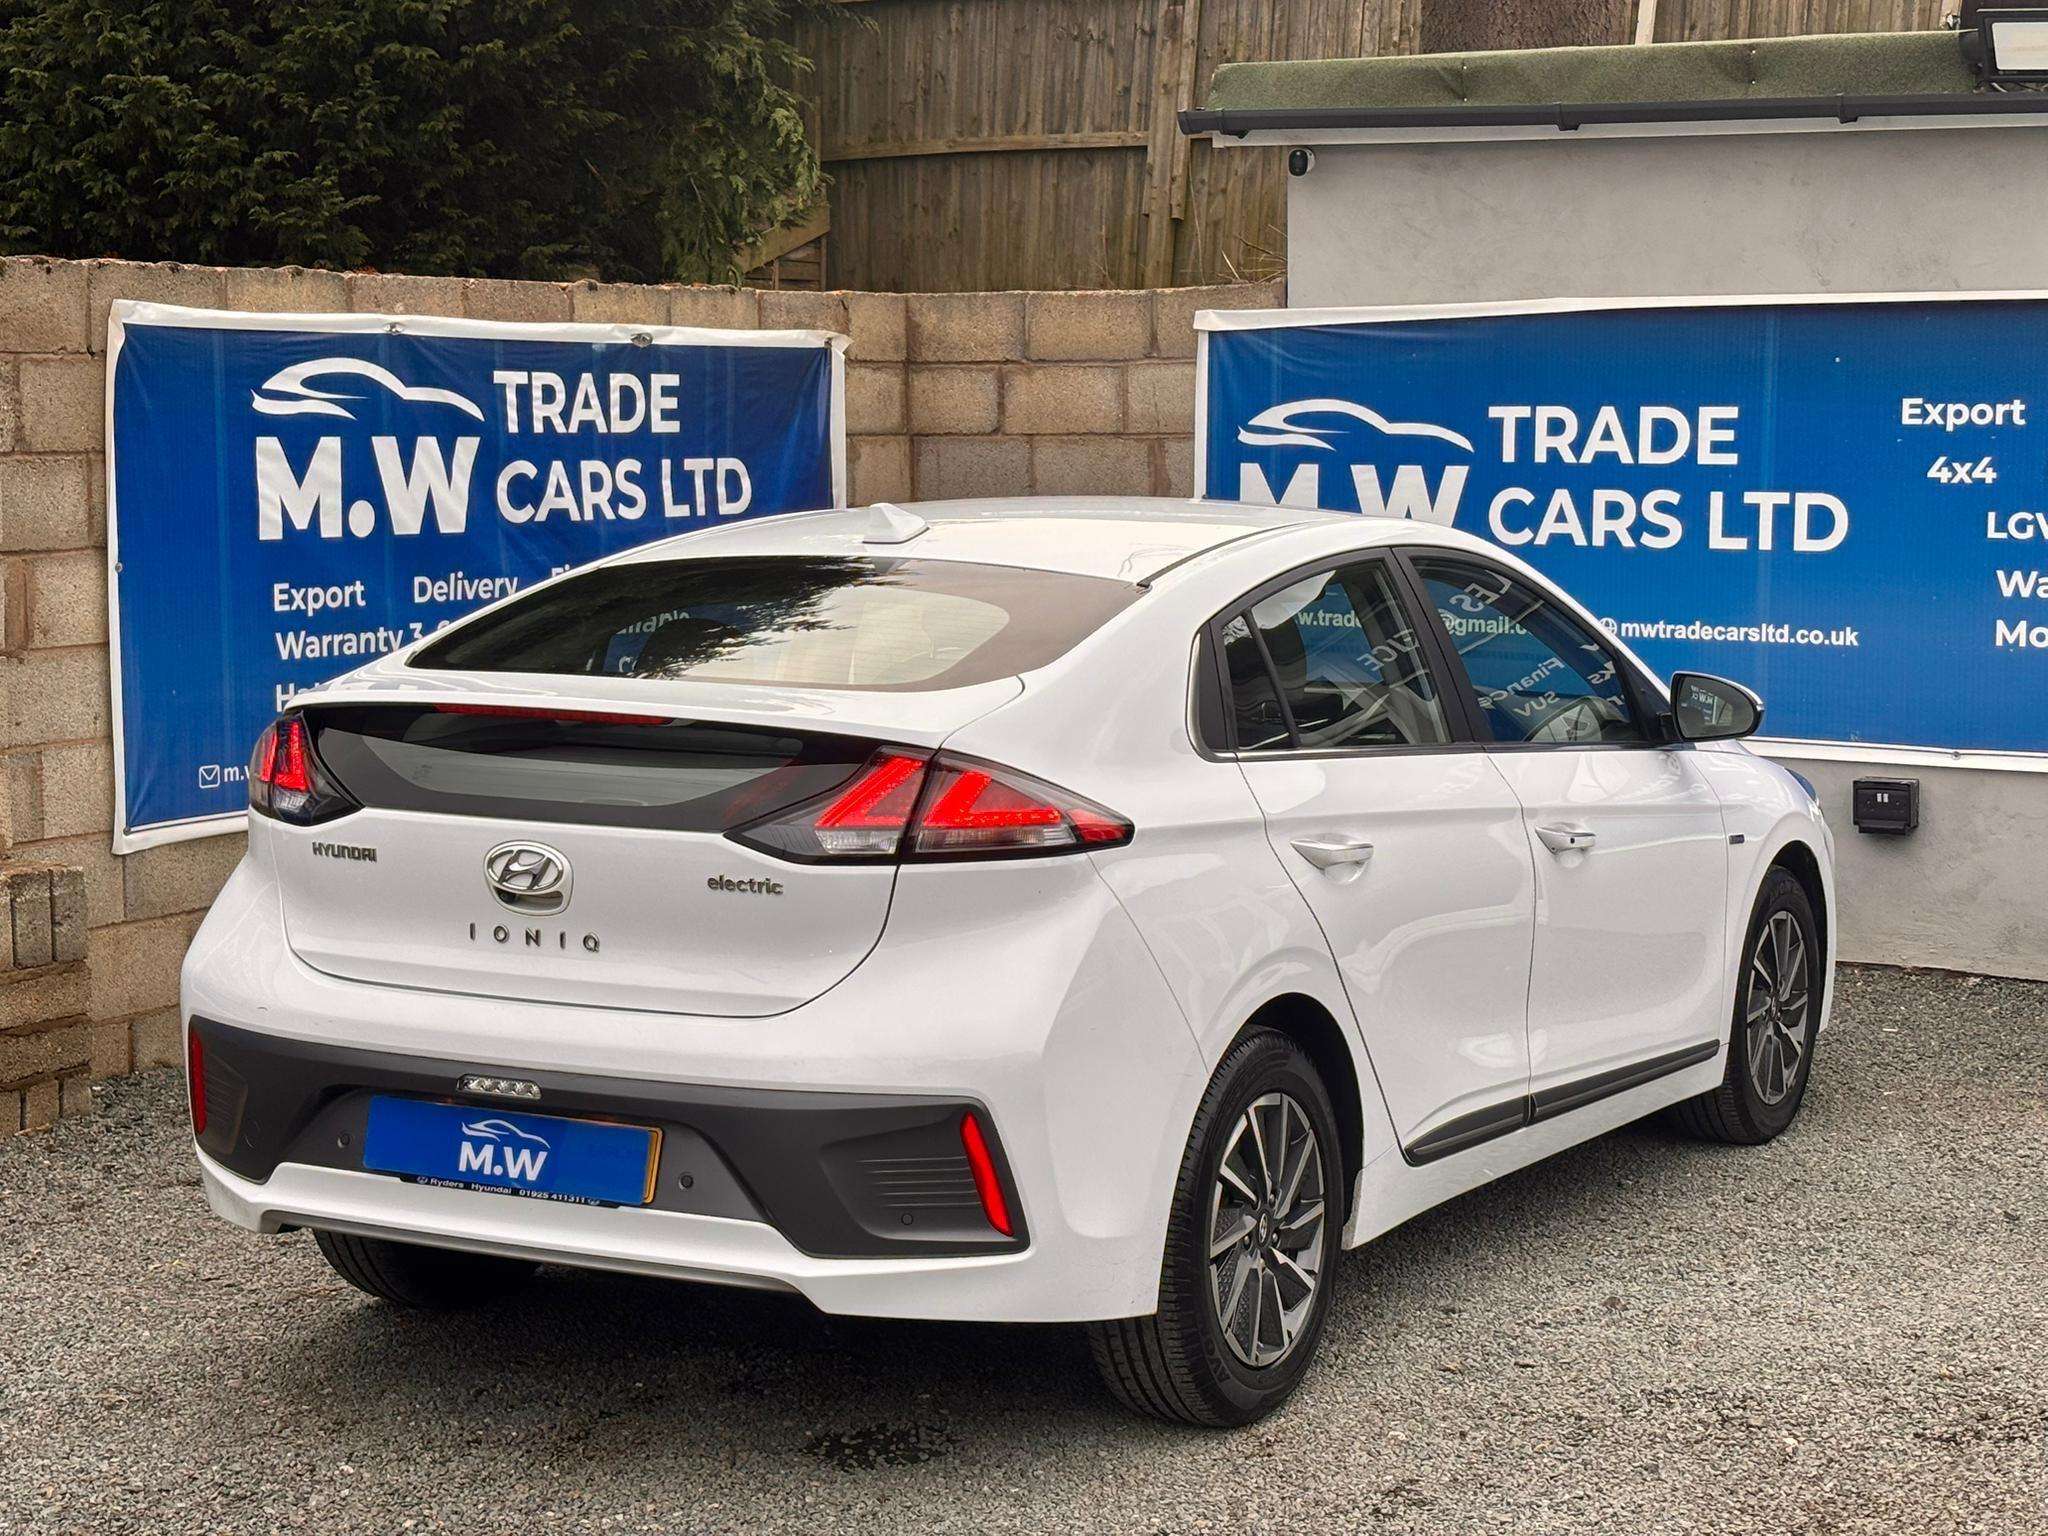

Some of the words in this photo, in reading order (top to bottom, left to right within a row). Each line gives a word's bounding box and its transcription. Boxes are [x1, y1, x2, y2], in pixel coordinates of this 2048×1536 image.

[493, 371, 680, 434] TRADE
[1901, 397, 2027, 432] Export
[1488, 405, 1739, 465] TRADE
[1926, 456, 1997, 484] 4x4
[255, 436, 481, 541] M.W
[497, 458, 647, 524] CARS
[661, 457, 752, 519] LTD
[1488, 487, 1683, 549] CARS
[1709, 491, 1849, 552] LTD
[273, 580, 366, 617] Export
[413, 571, 518, 604] Delivery
[275, 625, 403, 660] Warranty
[1621, 618, 1859, 647] mwtradecarsltd.co.uk
[1995, 619, 2048, 648] Mo
[312, 842, 378, 862] HYUNDAI
[707, 874, 784, 894] electric
[469, 922, 600, 952] IONIQ
[458, 1141, 548, 1181] M.W
[430, 1177, 465, 1189] Ryders
[471, 1183, 512, 1195] Hyundai
[519, 1188, 549, 1199] 01925
